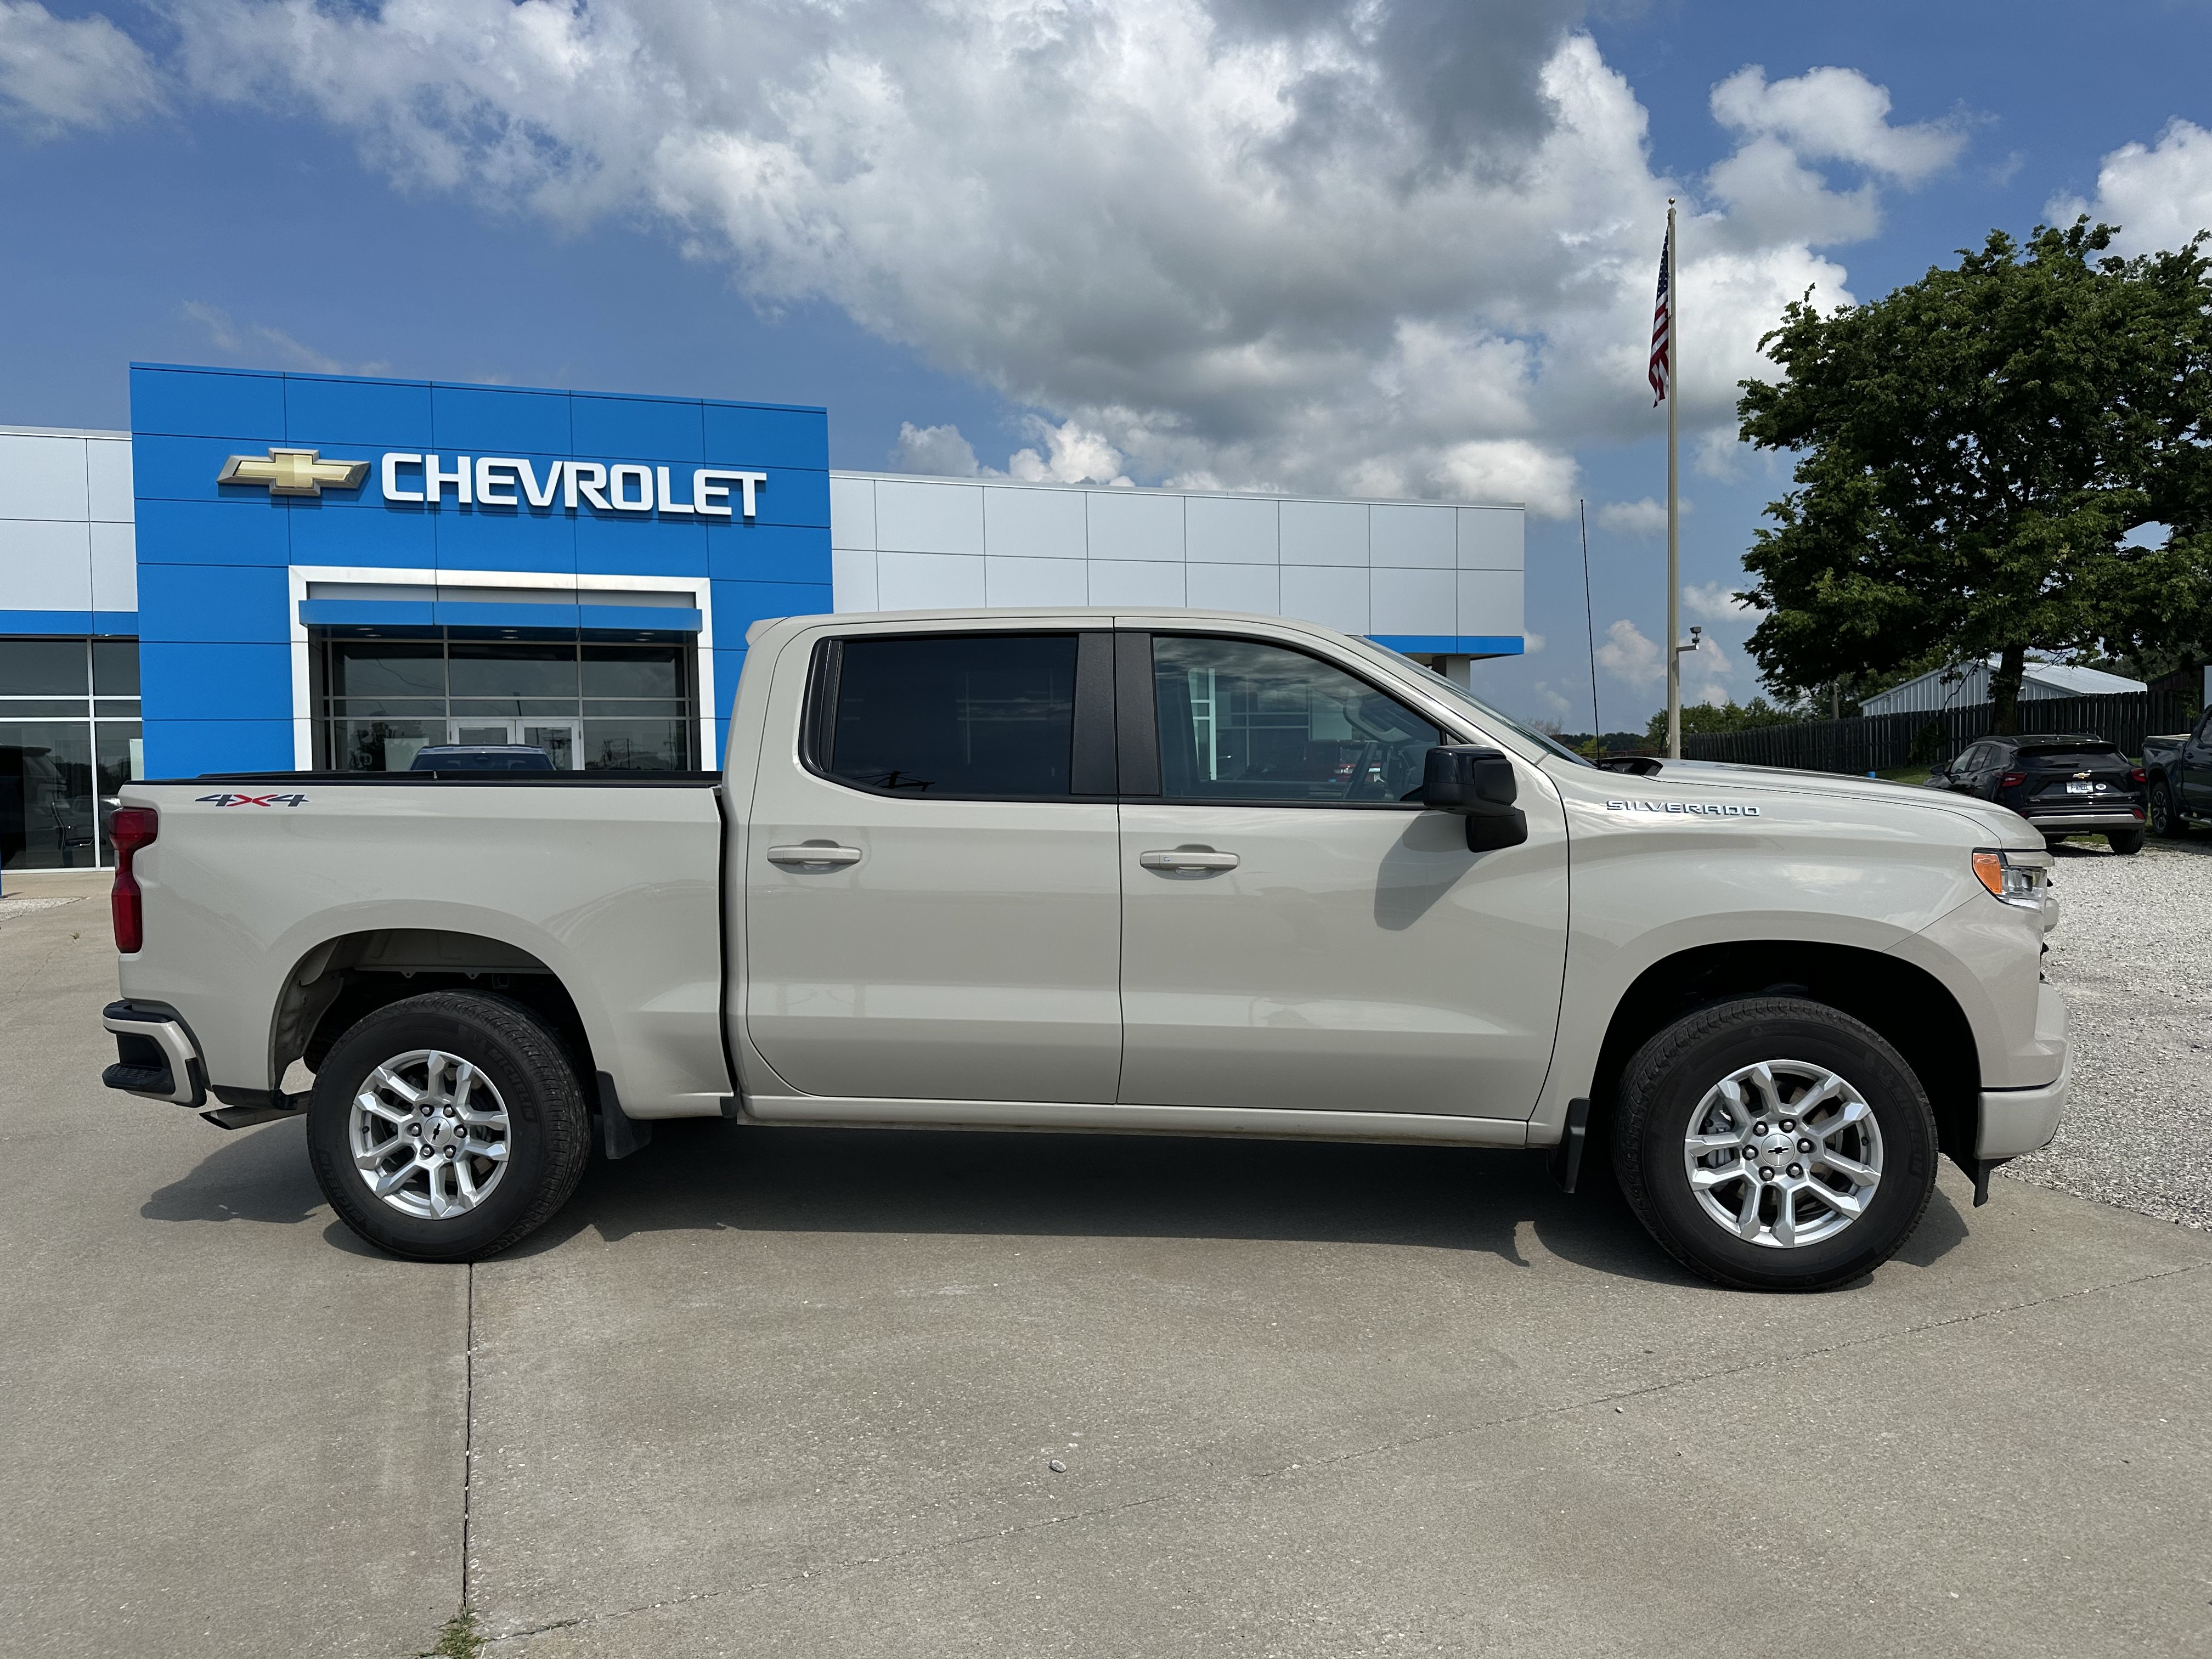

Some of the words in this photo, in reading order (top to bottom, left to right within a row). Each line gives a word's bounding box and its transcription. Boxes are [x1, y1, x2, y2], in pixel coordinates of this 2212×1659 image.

[381, 453, 766, 516] CHEVROLET
[1606, 800, 1760, 816] SILVERADO
[487, 1048, 537, 1120] MICHELIN
[1892, 1087, 1923, 1174] MICHELIN
[320, 1153, 366, 1222] MICHELIN
